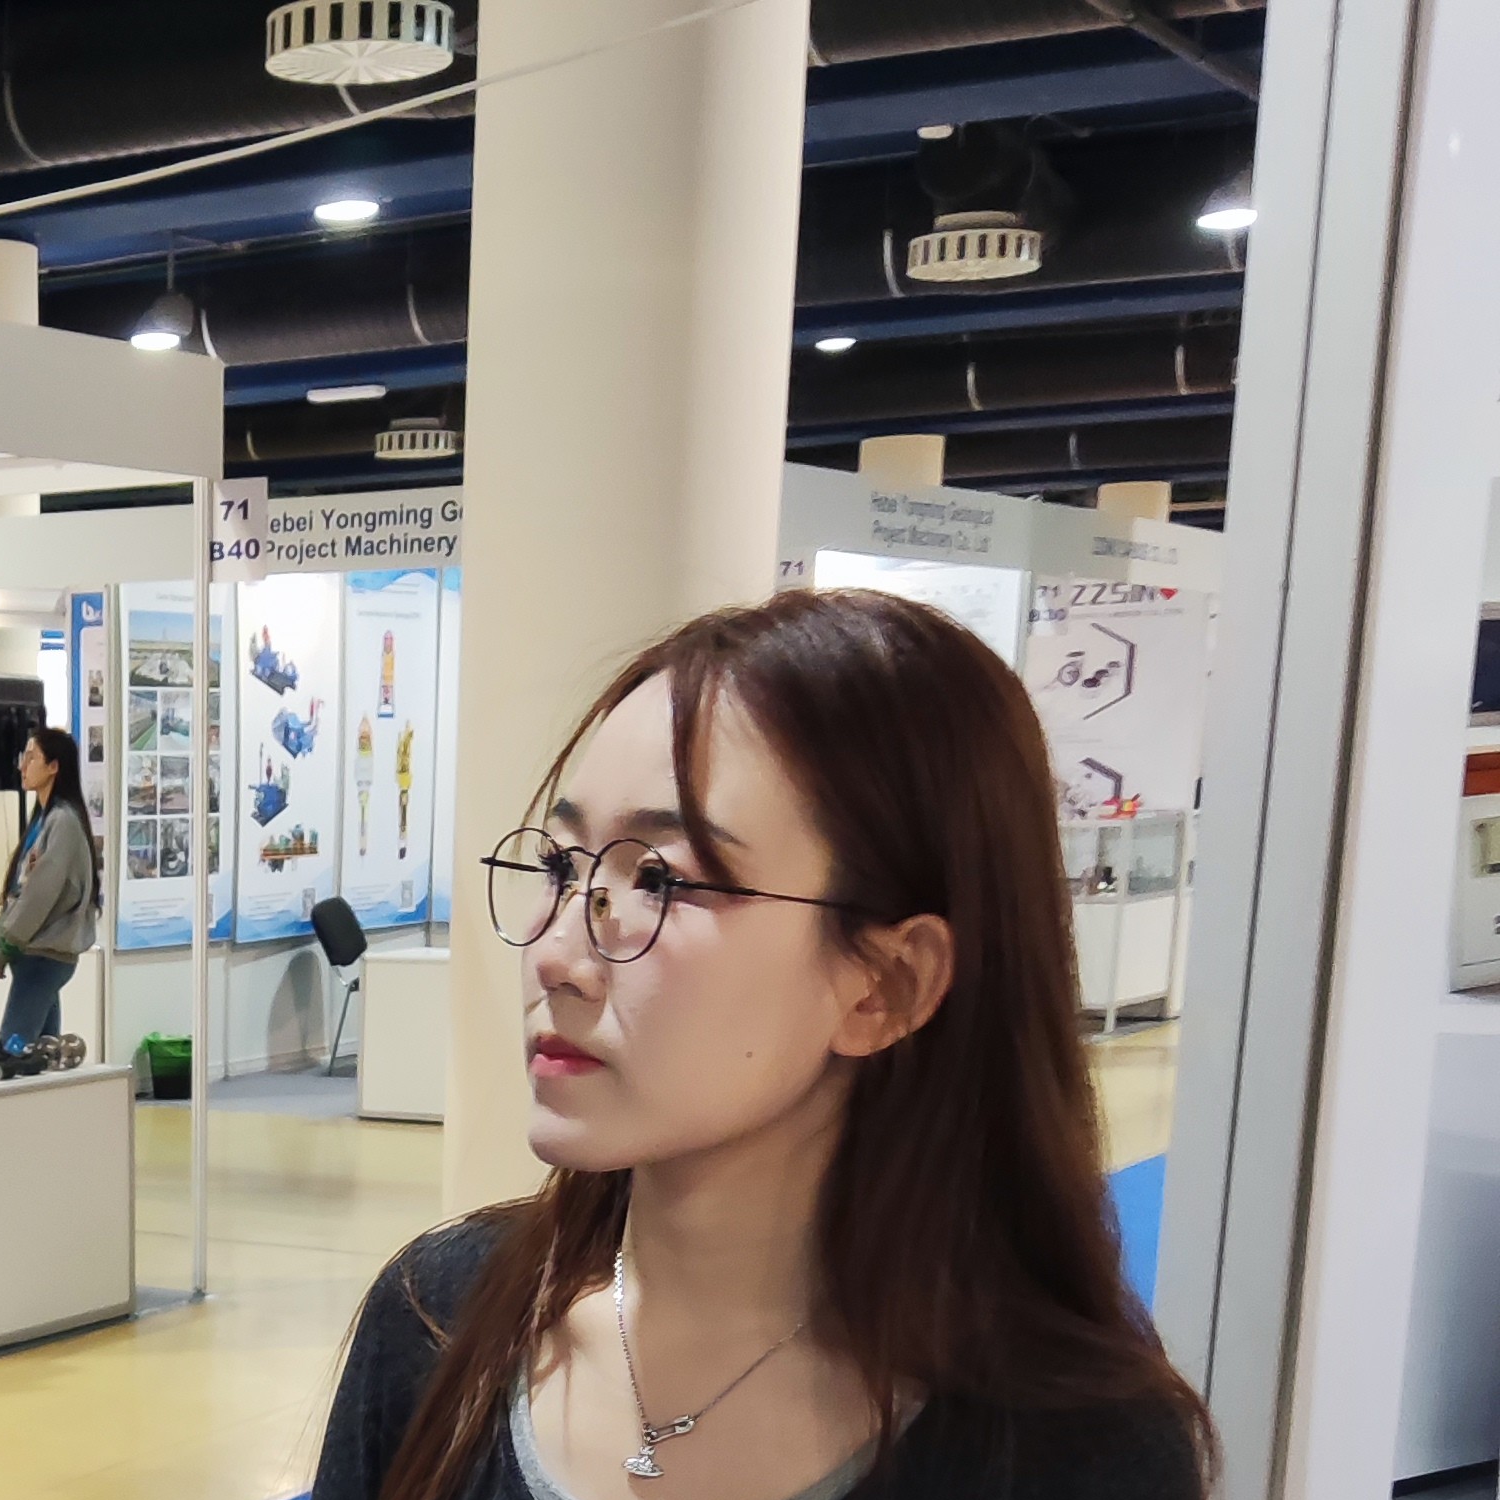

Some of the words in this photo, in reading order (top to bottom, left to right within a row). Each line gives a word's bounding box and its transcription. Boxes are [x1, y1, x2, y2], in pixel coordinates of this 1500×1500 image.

[219, 498, 249, 521] 71
[269, 510, 314, 534] ebei
[321, 504, 433, 533] Yongming
[210, 538, 261, 562] B40
[345, 532, 457, 558] Machinery
[780, 560, 805, 577] 71
